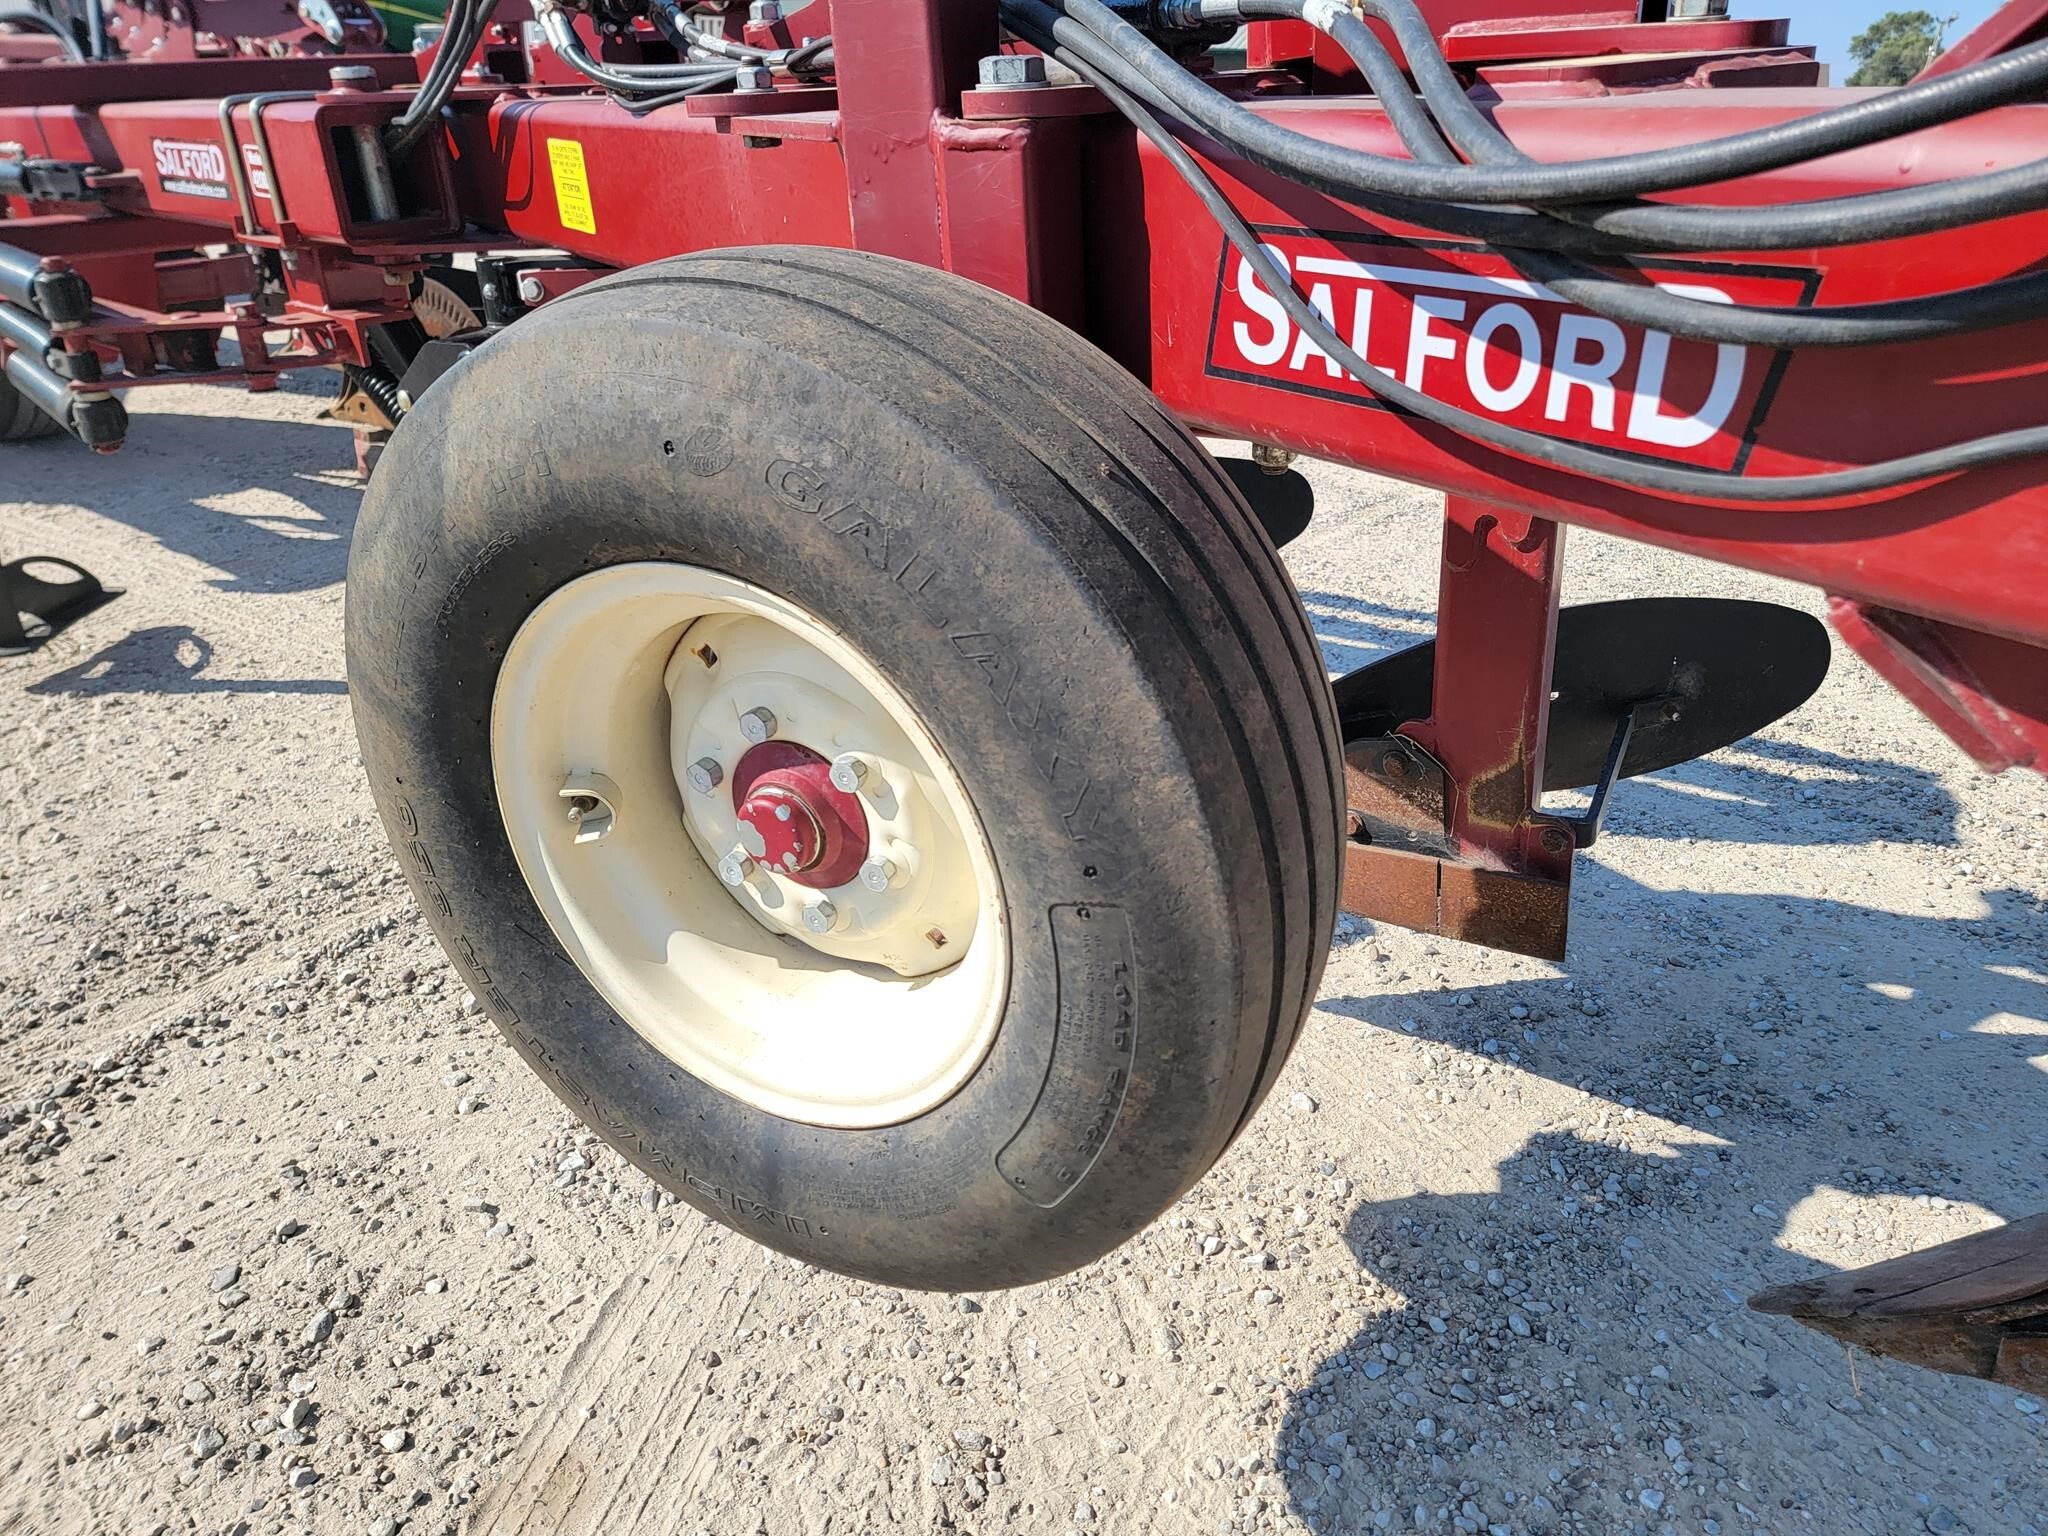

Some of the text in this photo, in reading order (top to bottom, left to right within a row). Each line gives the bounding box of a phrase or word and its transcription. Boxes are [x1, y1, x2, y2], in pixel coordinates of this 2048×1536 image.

[153, 138, 226, 181] SALFORD
[1234, 242, 1747, 448] SALFORD
[433, 529, 518, 632] TUBELESS
[764, 458, 1112, 843] GALAXY
[451, 932, 809, 1237] IMPMASTER
[1111, 961, 1130, 1054] LOAD
